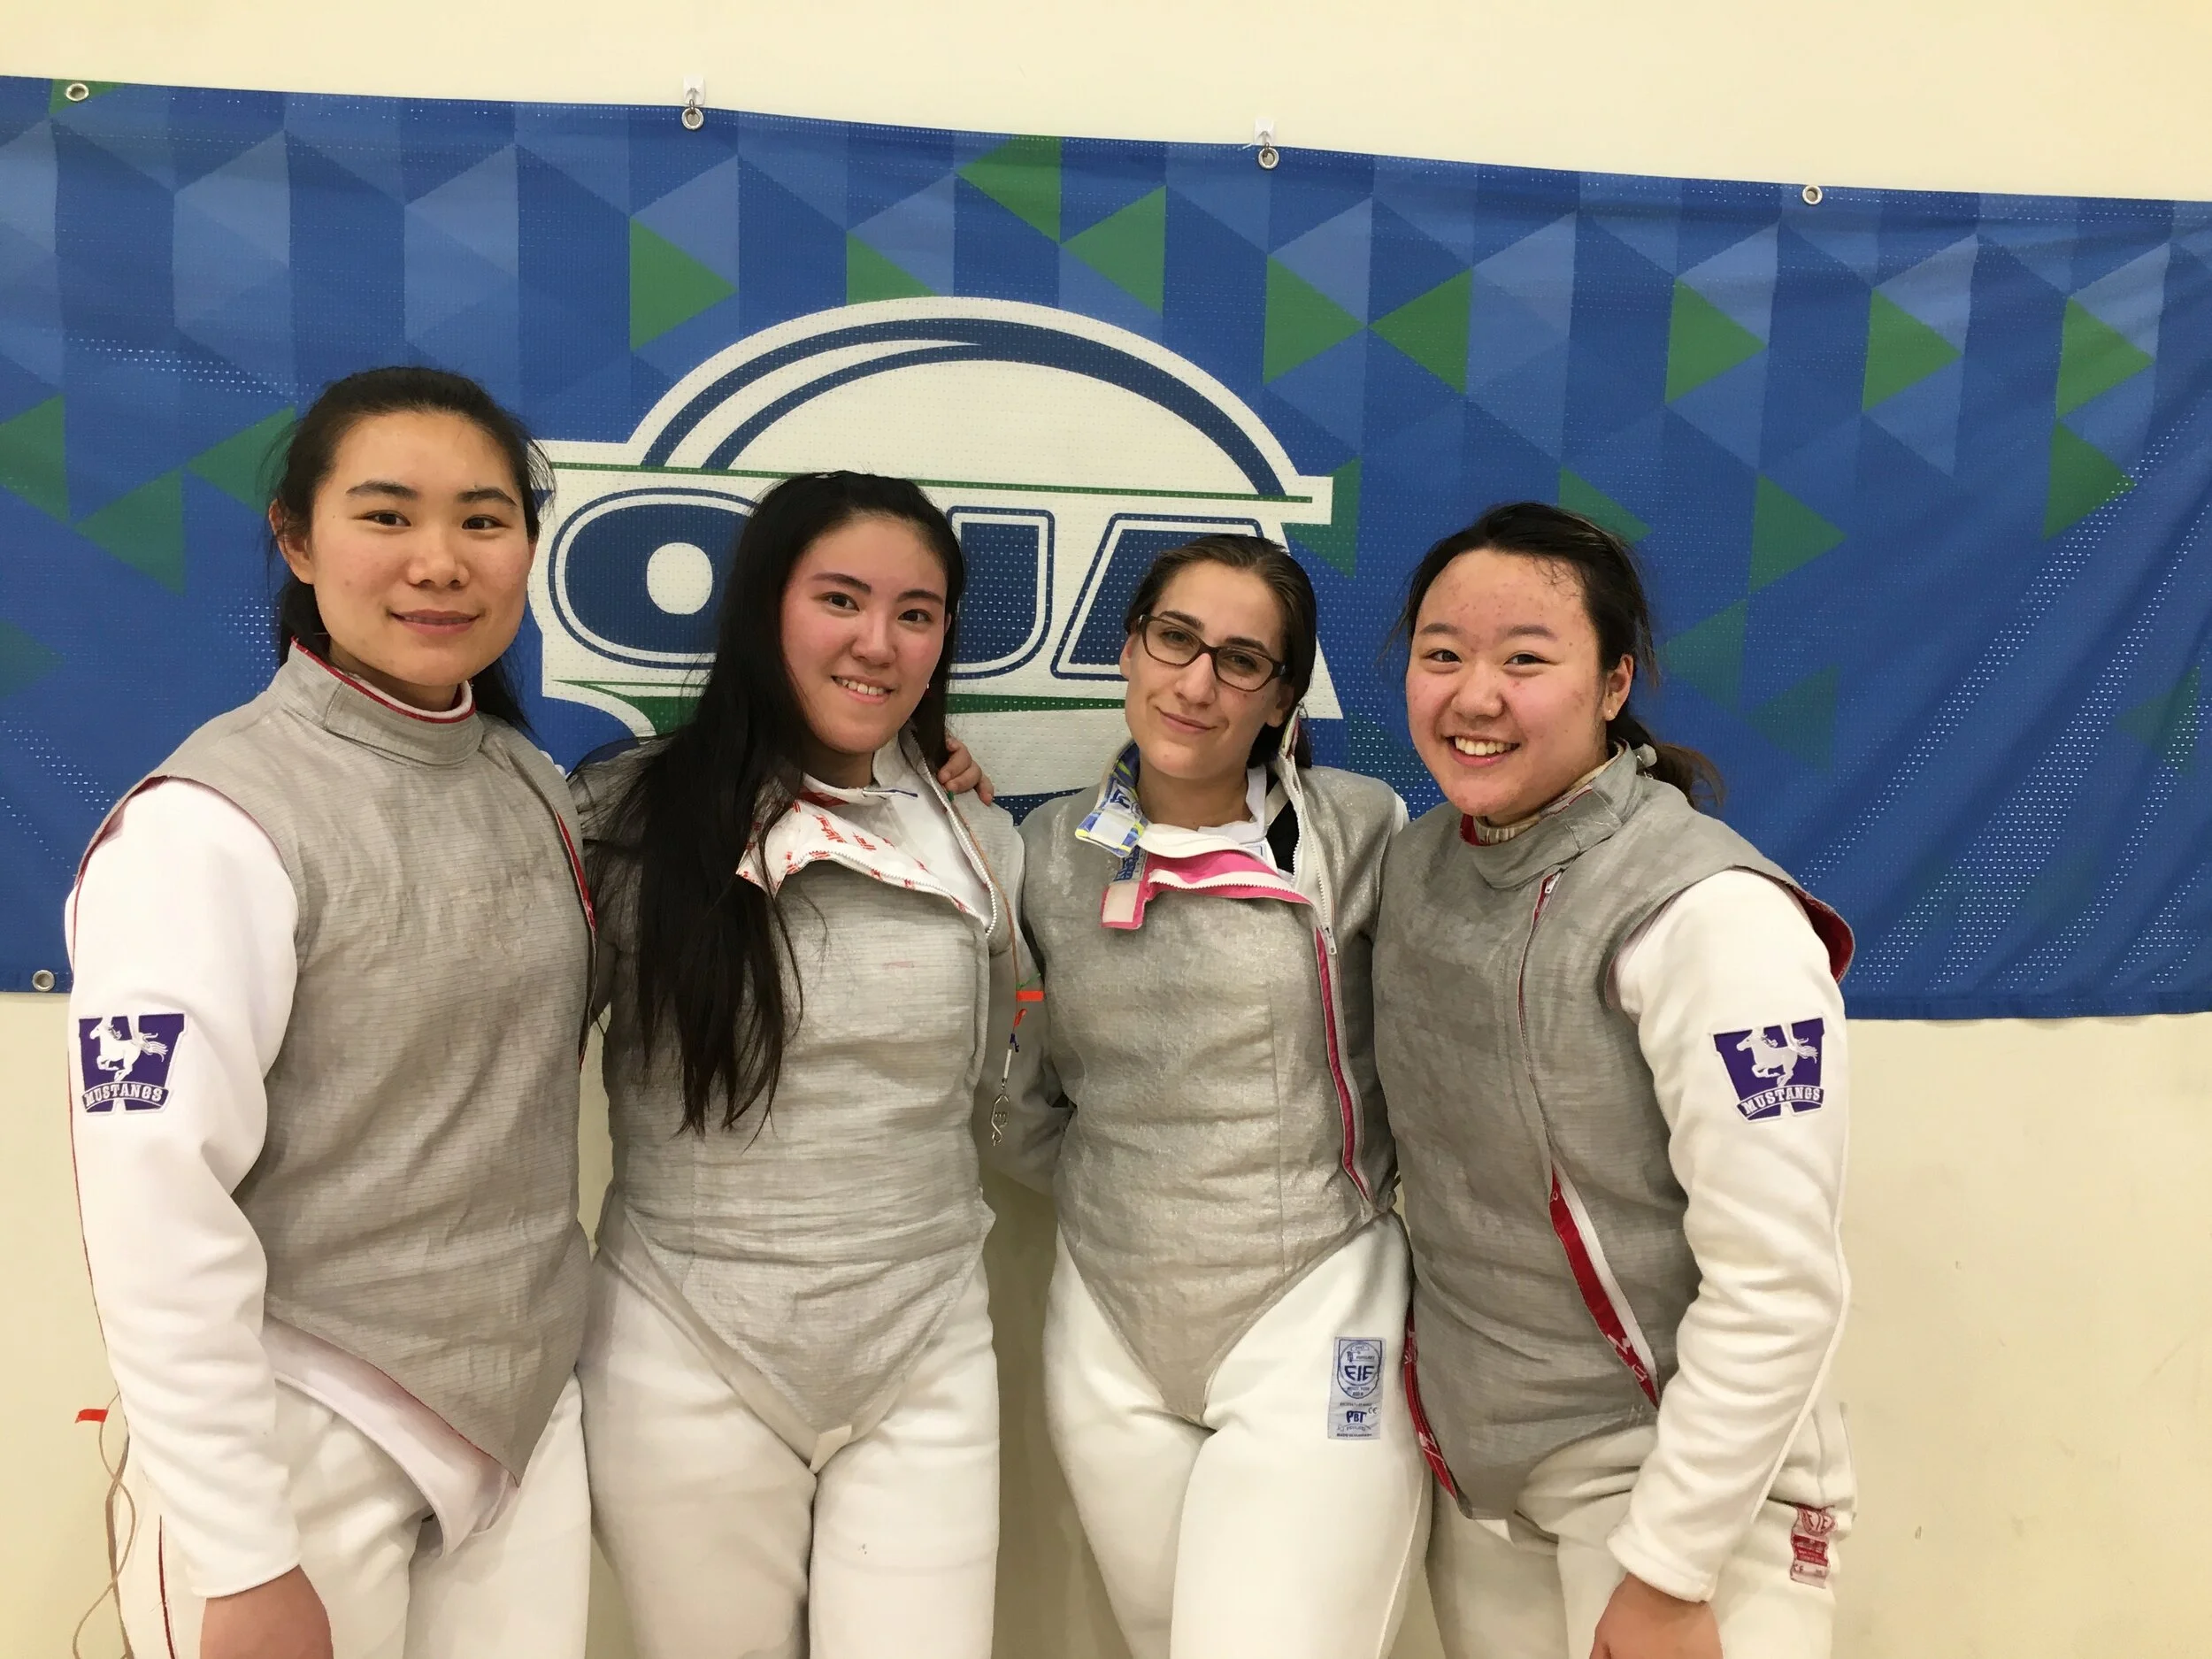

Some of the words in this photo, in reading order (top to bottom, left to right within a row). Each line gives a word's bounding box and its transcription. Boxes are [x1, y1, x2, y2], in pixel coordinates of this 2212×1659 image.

[83, 1083, 164, 1108] MUSTANGS
[1740, 1087, 1822, 1115] MUSTANGS
[1346, 1410, 1368, 1423] PBT
